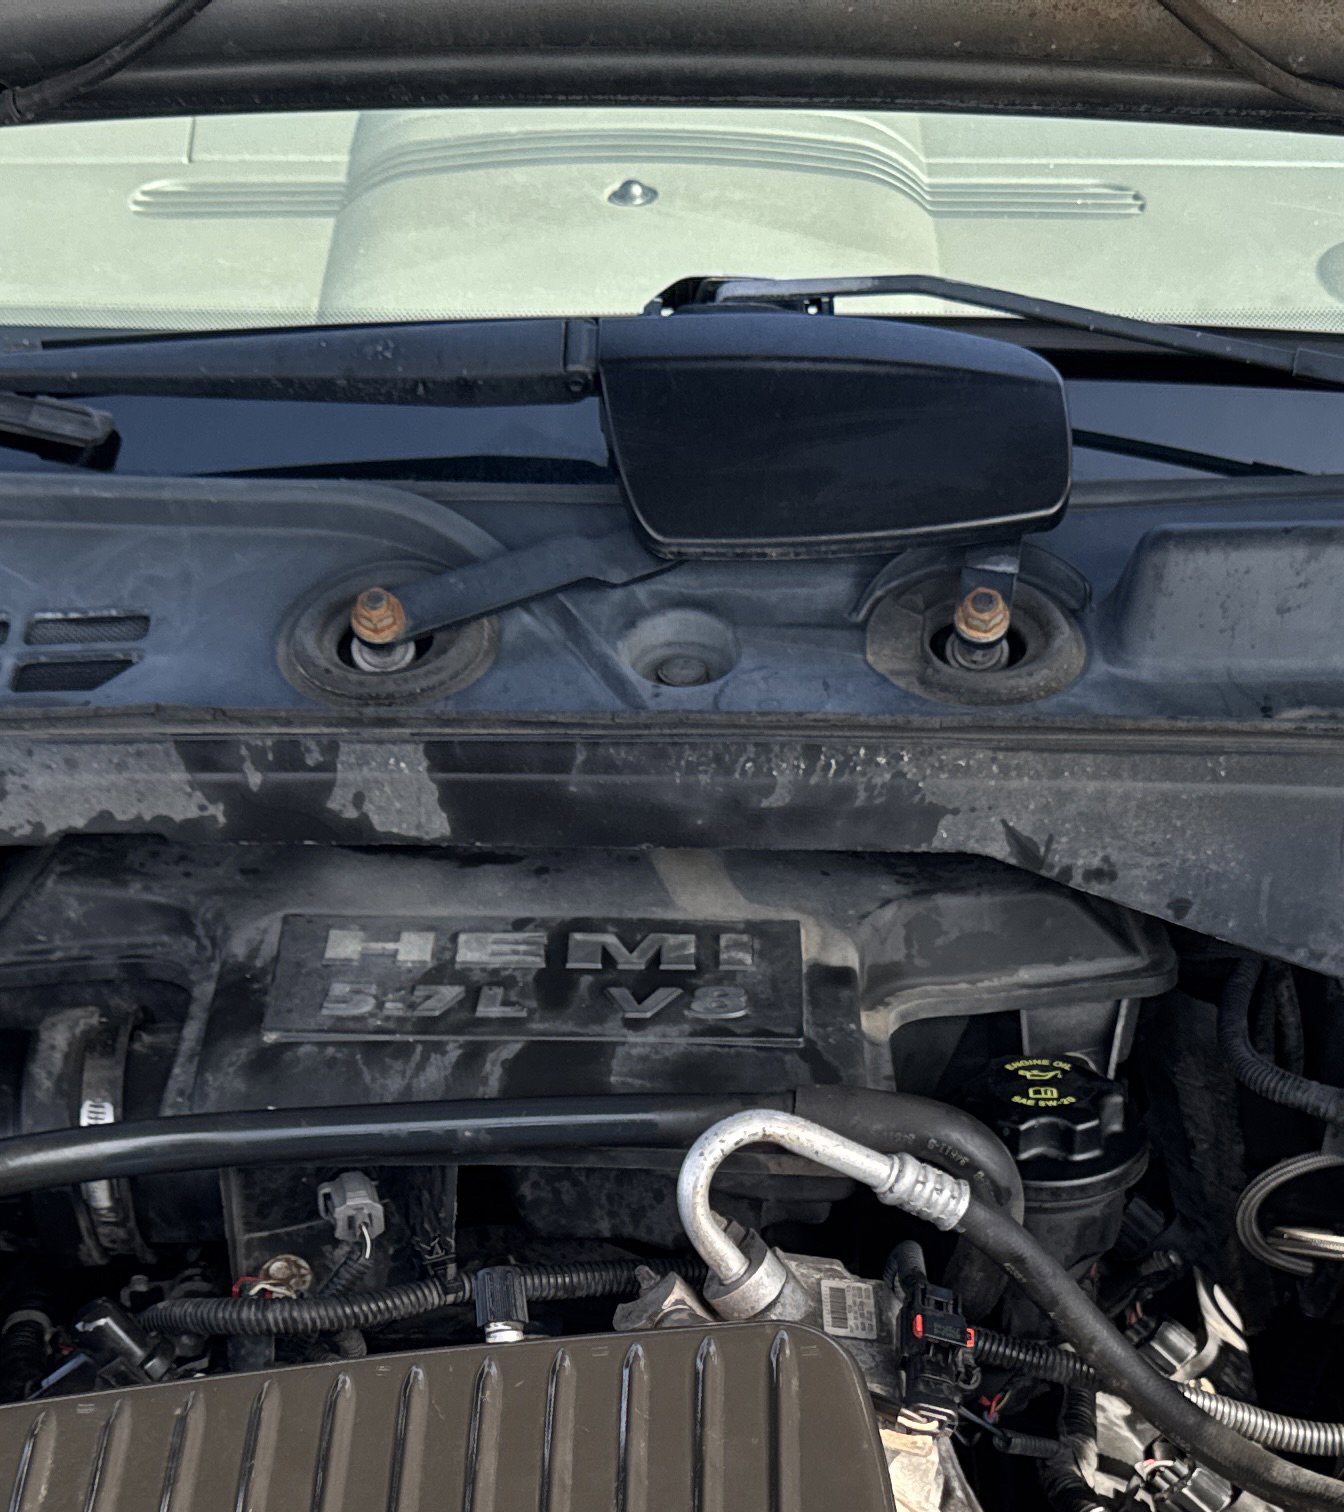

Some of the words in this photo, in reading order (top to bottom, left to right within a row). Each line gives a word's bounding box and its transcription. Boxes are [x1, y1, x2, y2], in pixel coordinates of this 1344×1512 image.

[321, 930, 754, 971] HEMI
[321, 983, 531, 1018] 5.7L
[605, 985, 750, 1019] V8
[1004, 1059, 1050, 1071] ENGINE
[1052, 1061, 1072, 1071] OIL
[1011, 1095, 1035, 1106] SAE
